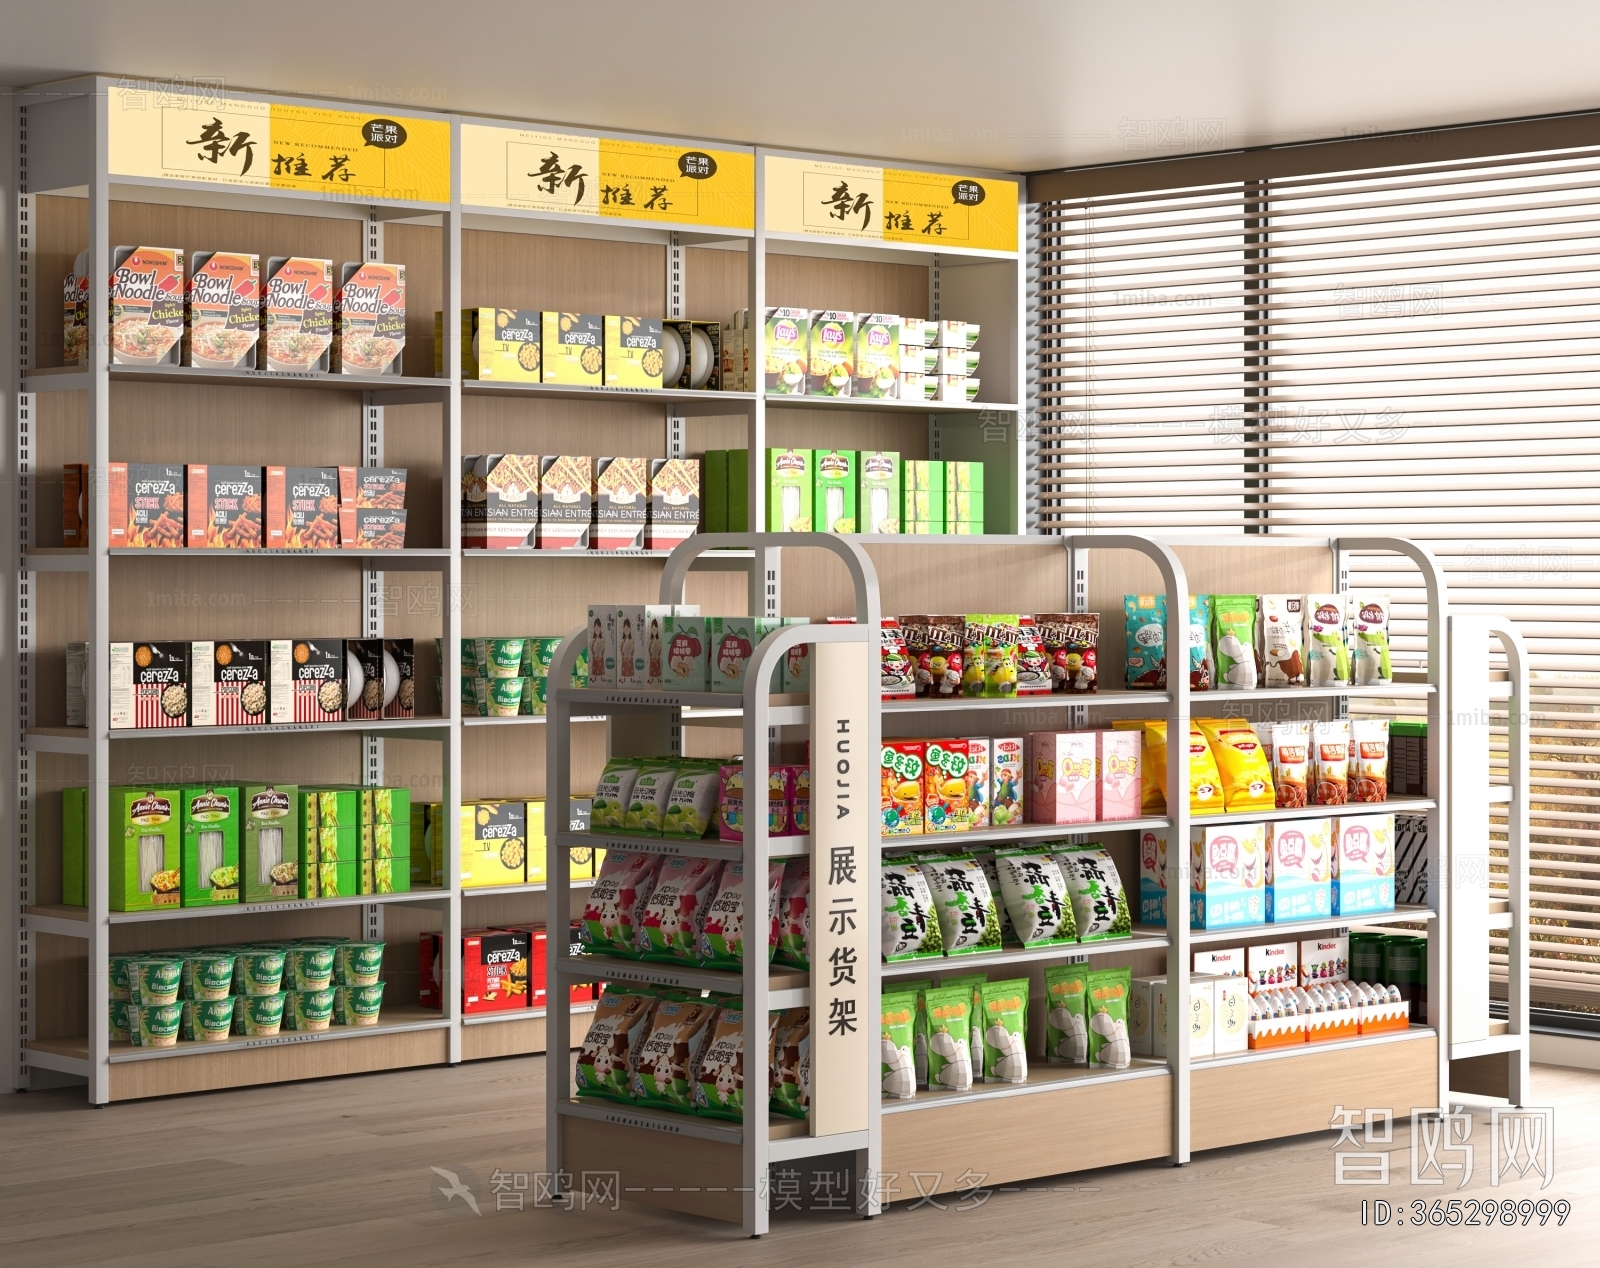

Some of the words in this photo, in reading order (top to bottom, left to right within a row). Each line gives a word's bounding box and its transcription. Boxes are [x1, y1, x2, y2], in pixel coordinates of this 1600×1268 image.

[370, 123, 398, 134] 芒果
[370, 133, 398, 144] 派对
[186, 117, 257, 177] 新
[295, 142, 358, 152] RECOMMENDED
[271, 152, 356, 182] 推荐
[686, 156, 709, 165] 芒果
[686, 165, 709, 175] 派对
[528, 151, 588, 206] 新
[620, 174, 675, 183] RECOMMENDED
[958, 184, 979, 193] 芒果
[958, 192, 979, 201] 派对
[600, 183, 673, 211] 推荐
[821, 180, 874, 232] 新
[901, 201, 949, 210] RECOMMENDED
[884, 210, 947, 235] 推荐
[116, 268, 157, 285] Bowl
[194, 274, 234, 290] Bowl
[114, 284, 164, 302] Noodle
[269, 279, 307, 295] Bowl
[344, 283, 381, 300] Bowl
[192, 289, 241, 306] Noodle
[267, 294, 315, 310] Noodle
[342, 298, 388, 315] Noodle
[836, 719, 850, 820] HUOJIA
[132, 802, 150, 814] Annie
[192, 800, 210, 811] Annie
[252, 797, 269, 808] Annie
[828, 846, 858, 1036] 展示货架
[1212, 954, 1231, 962] kinder
[1266, 948, 1284, 956] kinder
